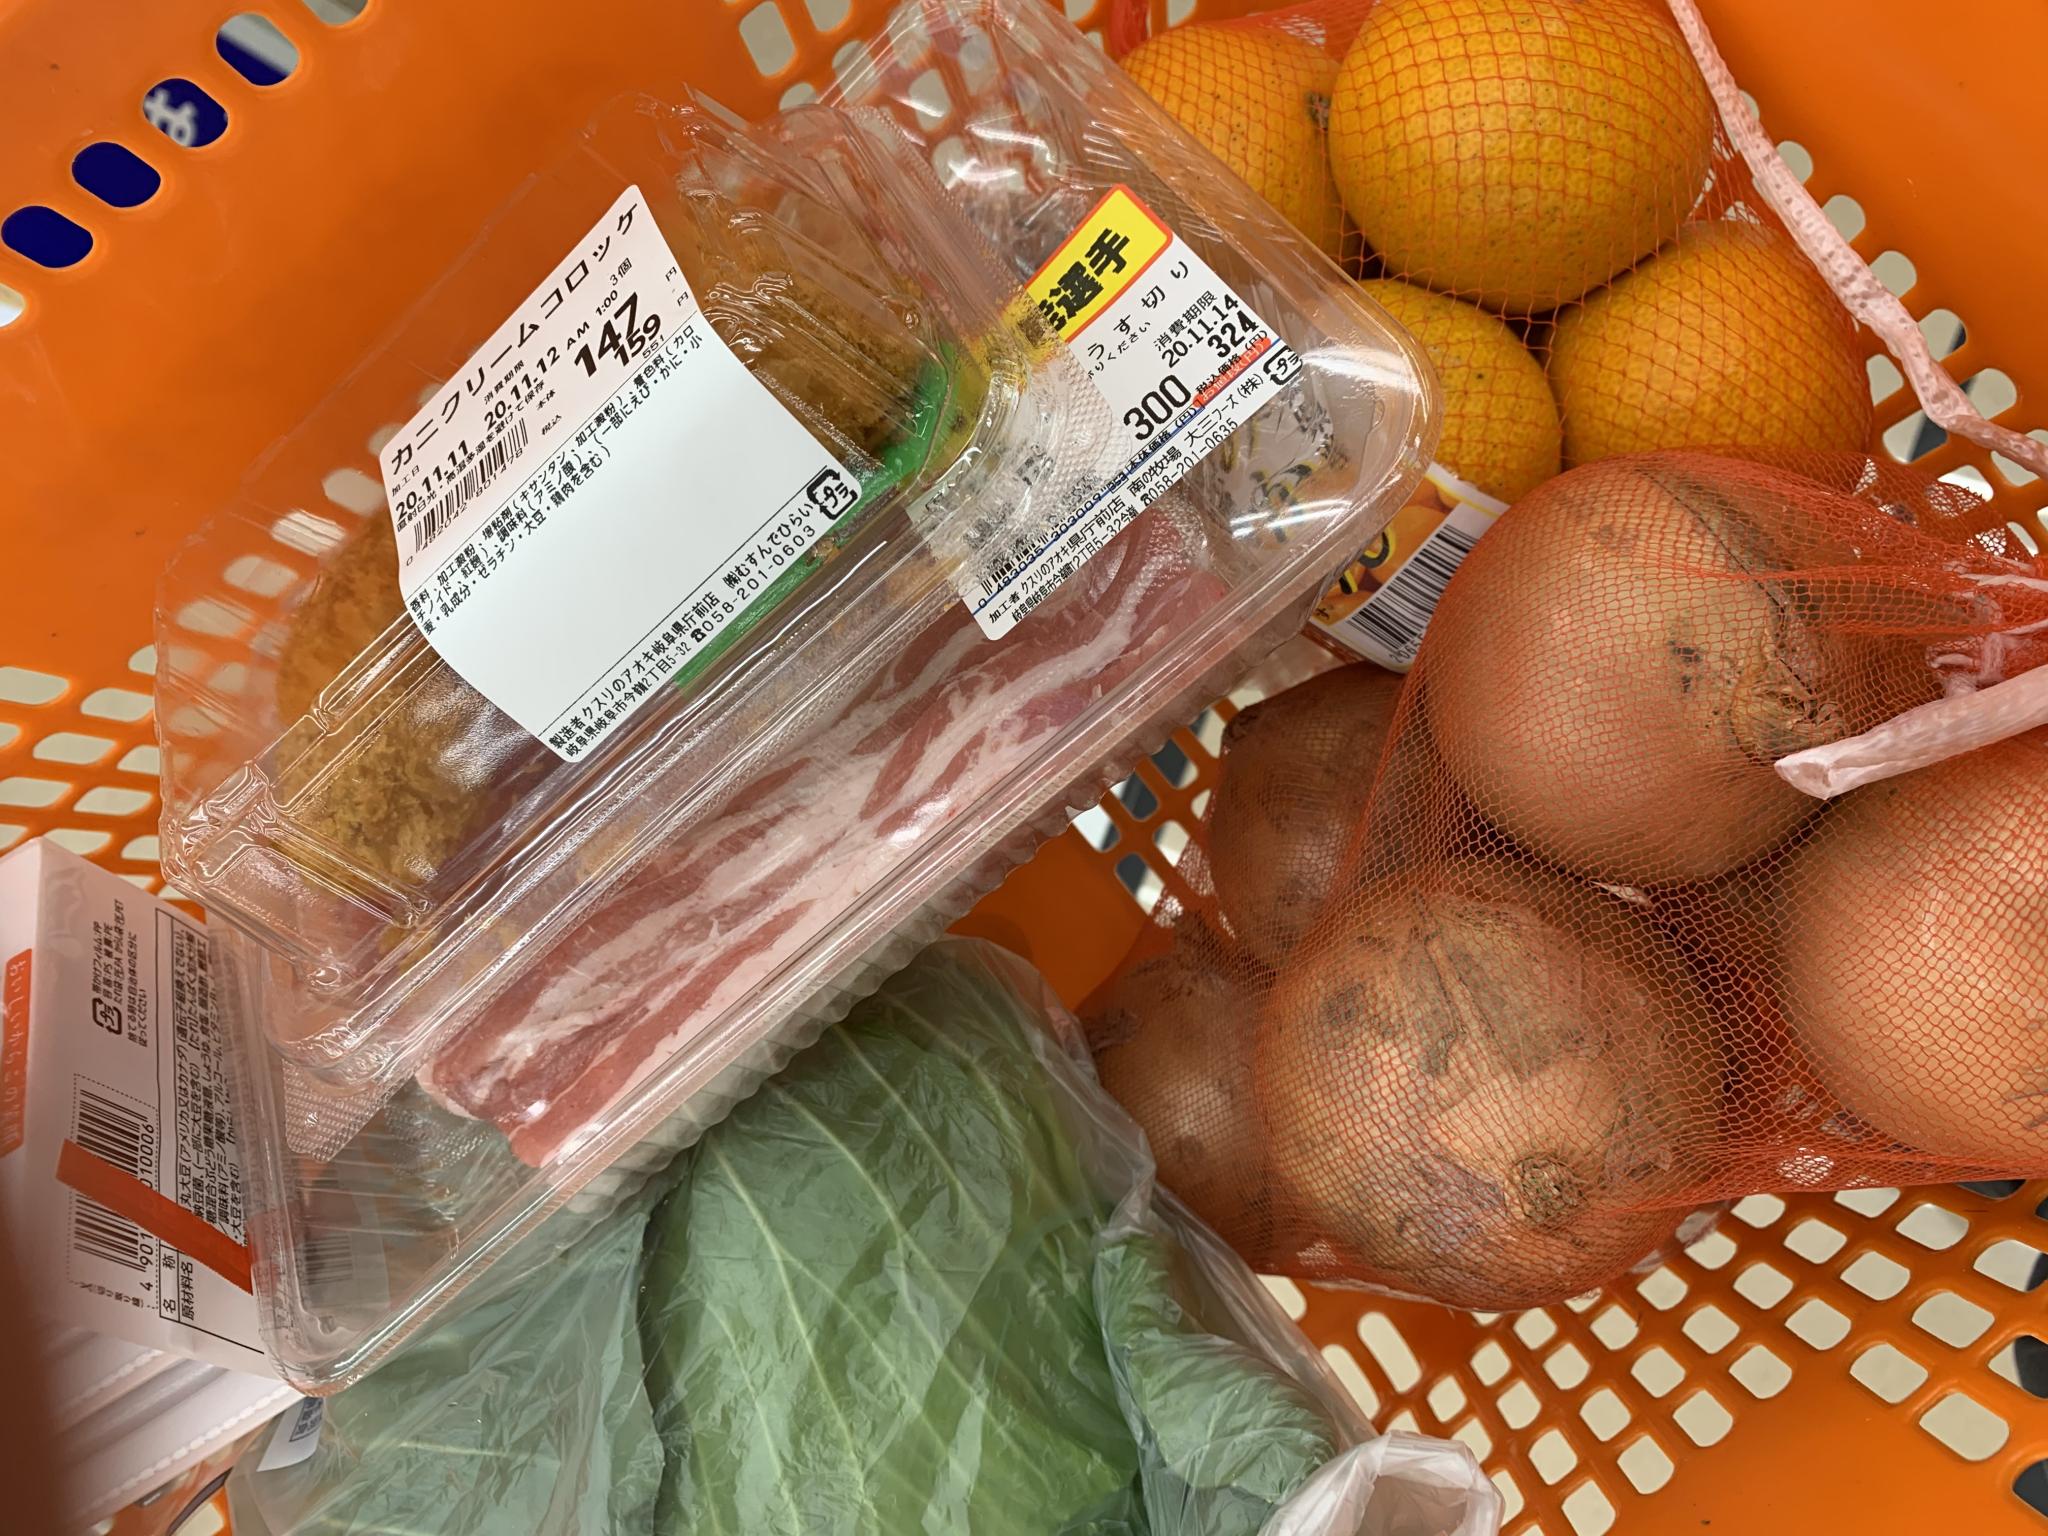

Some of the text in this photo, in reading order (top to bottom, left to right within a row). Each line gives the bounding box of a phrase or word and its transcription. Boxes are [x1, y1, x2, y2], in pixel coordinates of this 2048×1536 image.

[608, 257, 633, 286] 3個
[388, 202, 635, 475] カニクリームコロッケ
[536, 266, 677, 410] 本体 147 円
[642, 333, 665, 358] 551
[1152, 289, 1217, 351] 消費期限
[1160, 293, 1240, 368] 20.11.14
[1206, 308, 1259, 359] 324
[483, 288, 618, 431] 20.11.12 AM 1:00
[484, 359, 525, 404] 消費期限
[541, 291, 689, 436] 税込 159 円
[1121, 372, 1193, 442] 300
[390, 464, 420, 496] 加工日
[395, 439, 469, 521] 20.11.11
[989, 591, 1022, 623] 加工者
[1020, 497, 1126, 594] クスリのアオキ県庁前店
[1127, 445, 1182, 496] 南の牧場
[994, 545, 1044, 592] 483035
[1050, 493, 1101, 542] 303009
[548, 715, 585, 749] 製造者
[582, 591, 720, 720] クスリのアオキ岐阜県庁前店
[139, 1281, 154, 1292] 4
[180, 1262, 195, 1321] 原材料名
